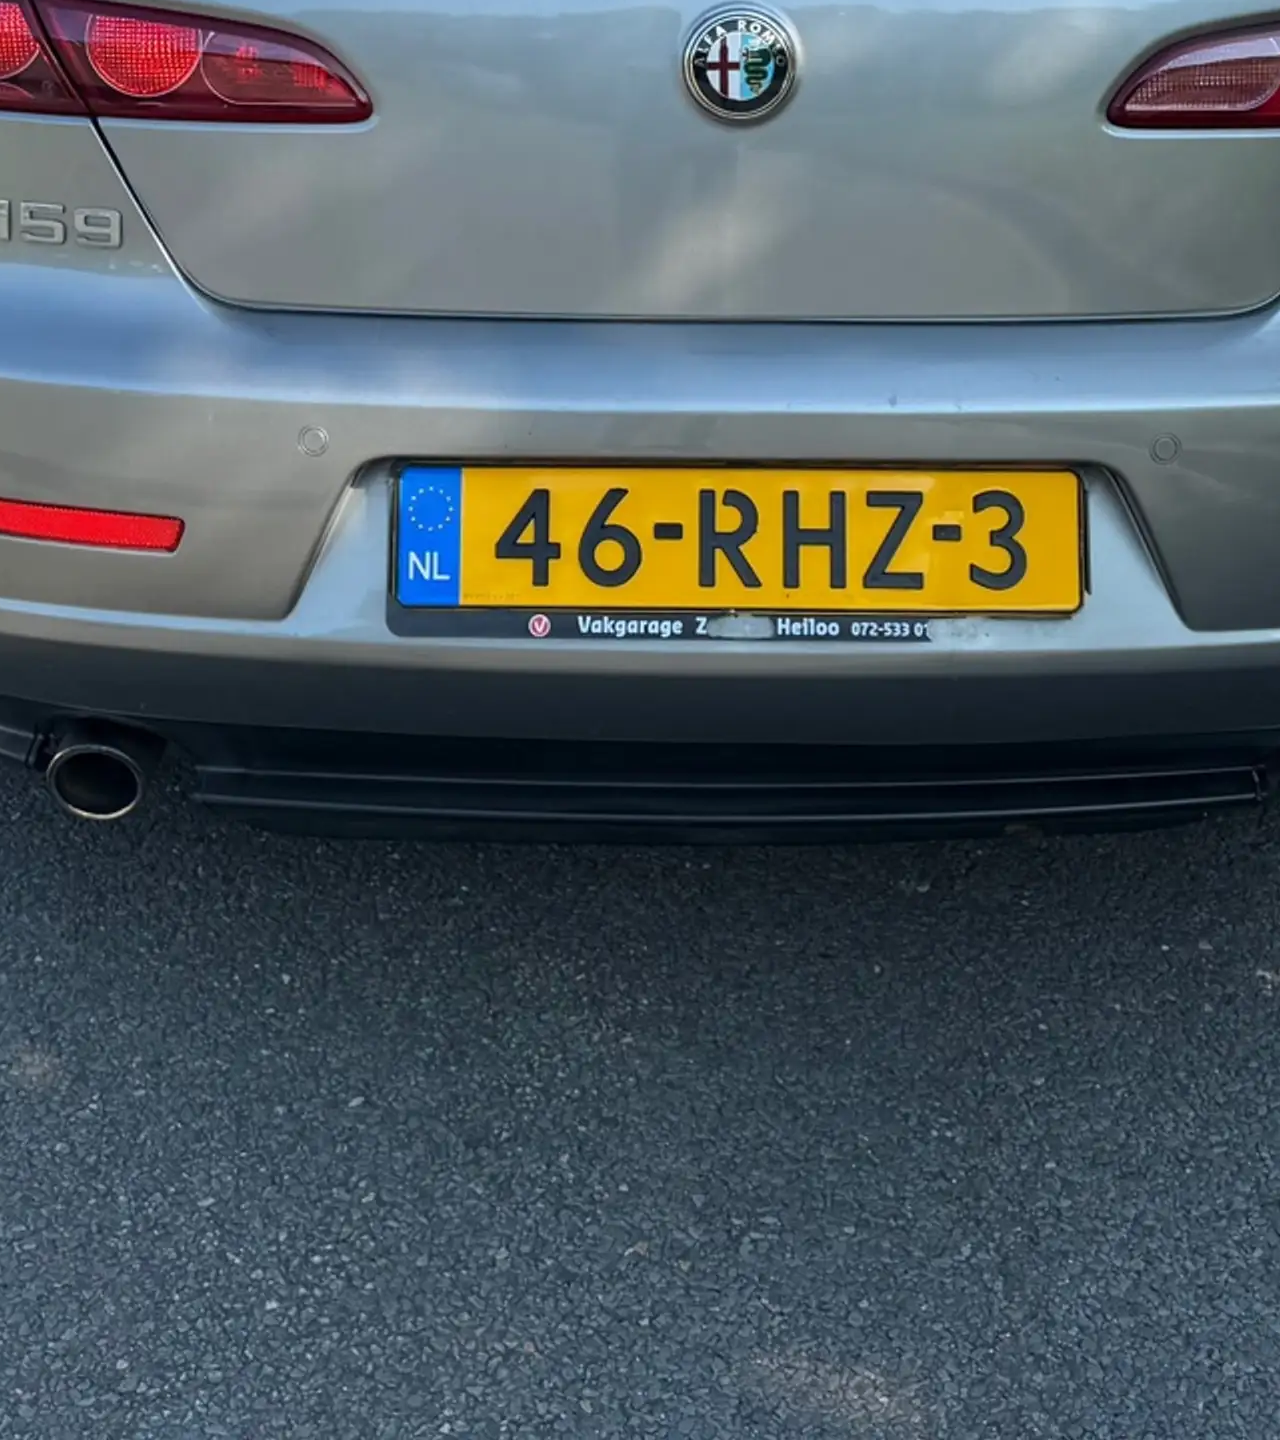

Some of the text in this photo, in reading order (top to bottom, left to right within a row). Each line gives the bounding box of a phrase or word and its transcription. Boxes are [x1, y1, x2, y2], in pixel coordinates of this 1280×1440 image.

[694, 20, 786, 67] ALFA ROMEO
[494, 488, 1028, 591] 46-RHZ-3
[408, 552, 451, 581] NL
[577, 615, 684, 638] Vakgarage
[777, 618, 840, 636] Heiloo
[850, 622, 910, 637] 072-533
